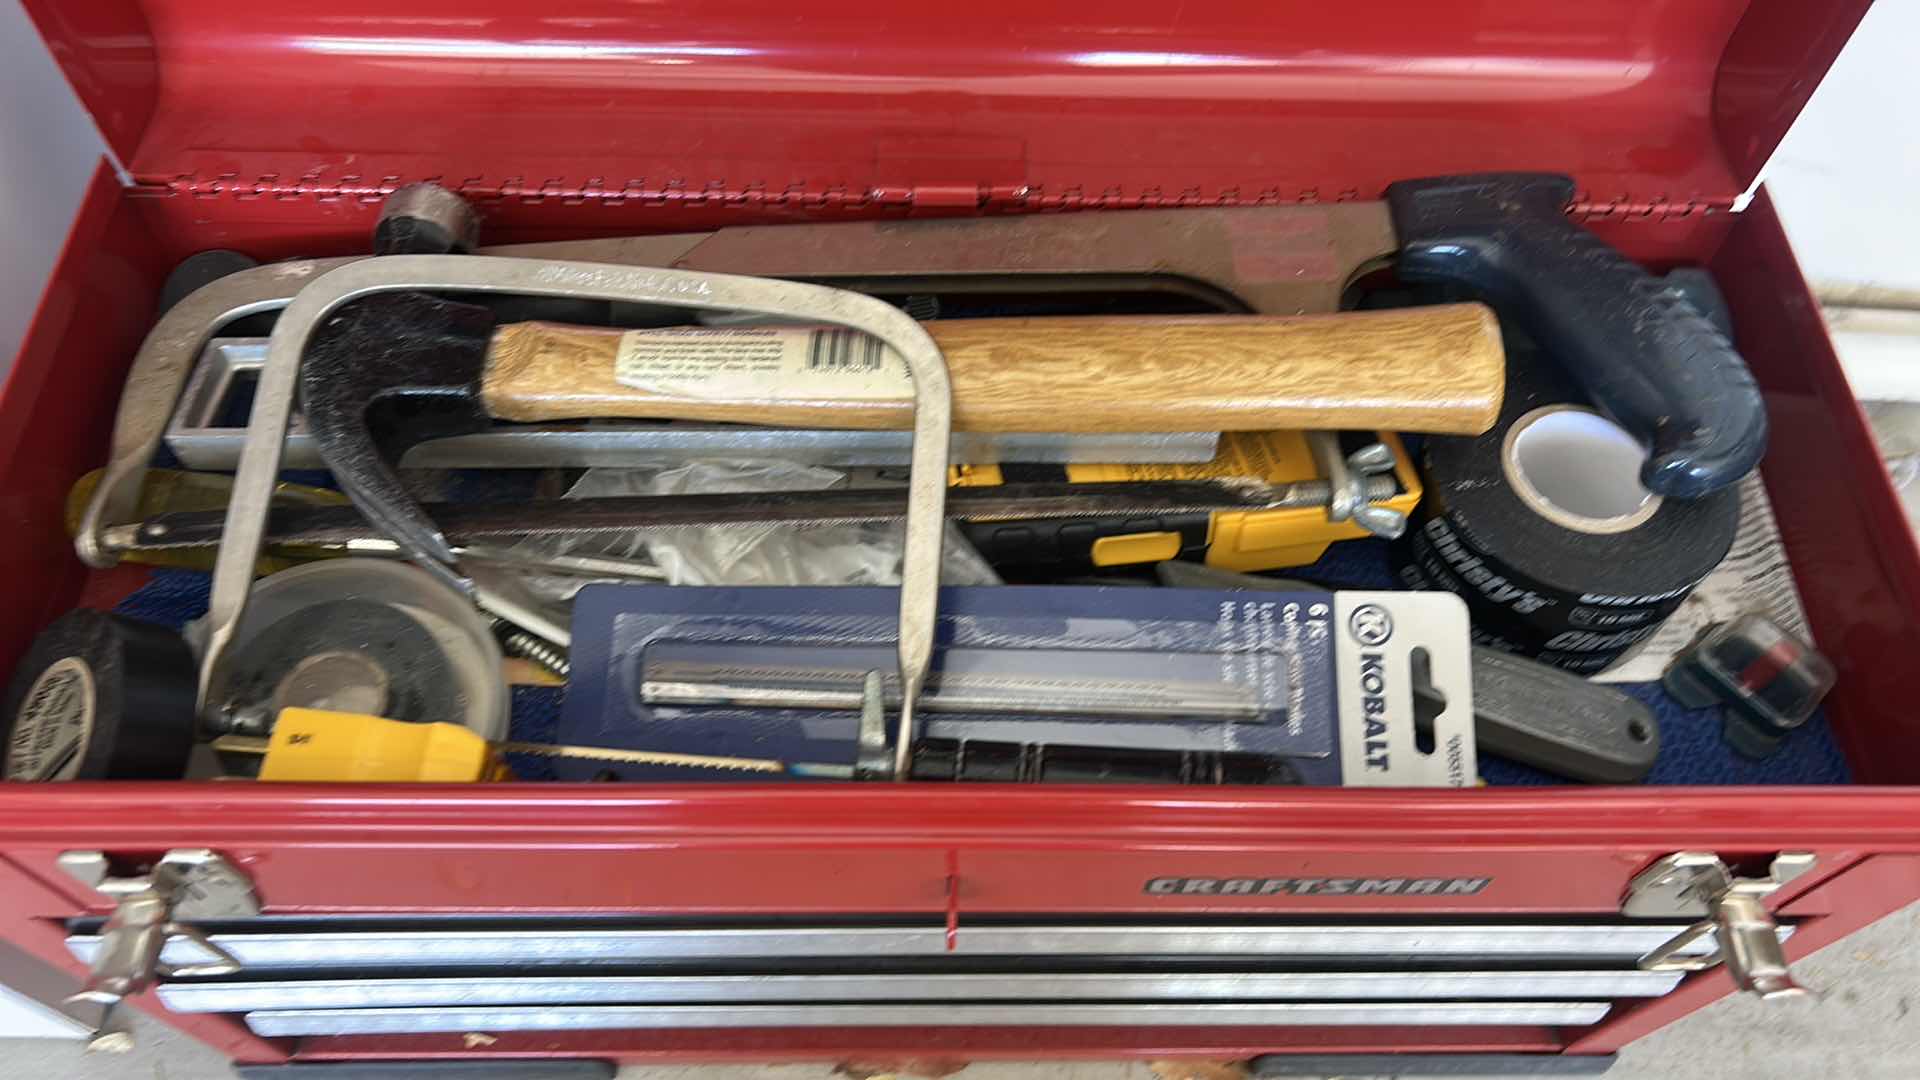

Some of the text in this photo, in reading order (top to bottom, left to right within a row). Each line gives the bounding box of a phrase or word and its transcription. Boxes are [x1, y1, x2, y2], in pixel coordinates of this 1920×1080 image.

[1308, 602, 1329, 617] 6
[1360, 652, 1389, 773] KOBALT
[1144, 876, 1491, 895] CRAFTSMAN
